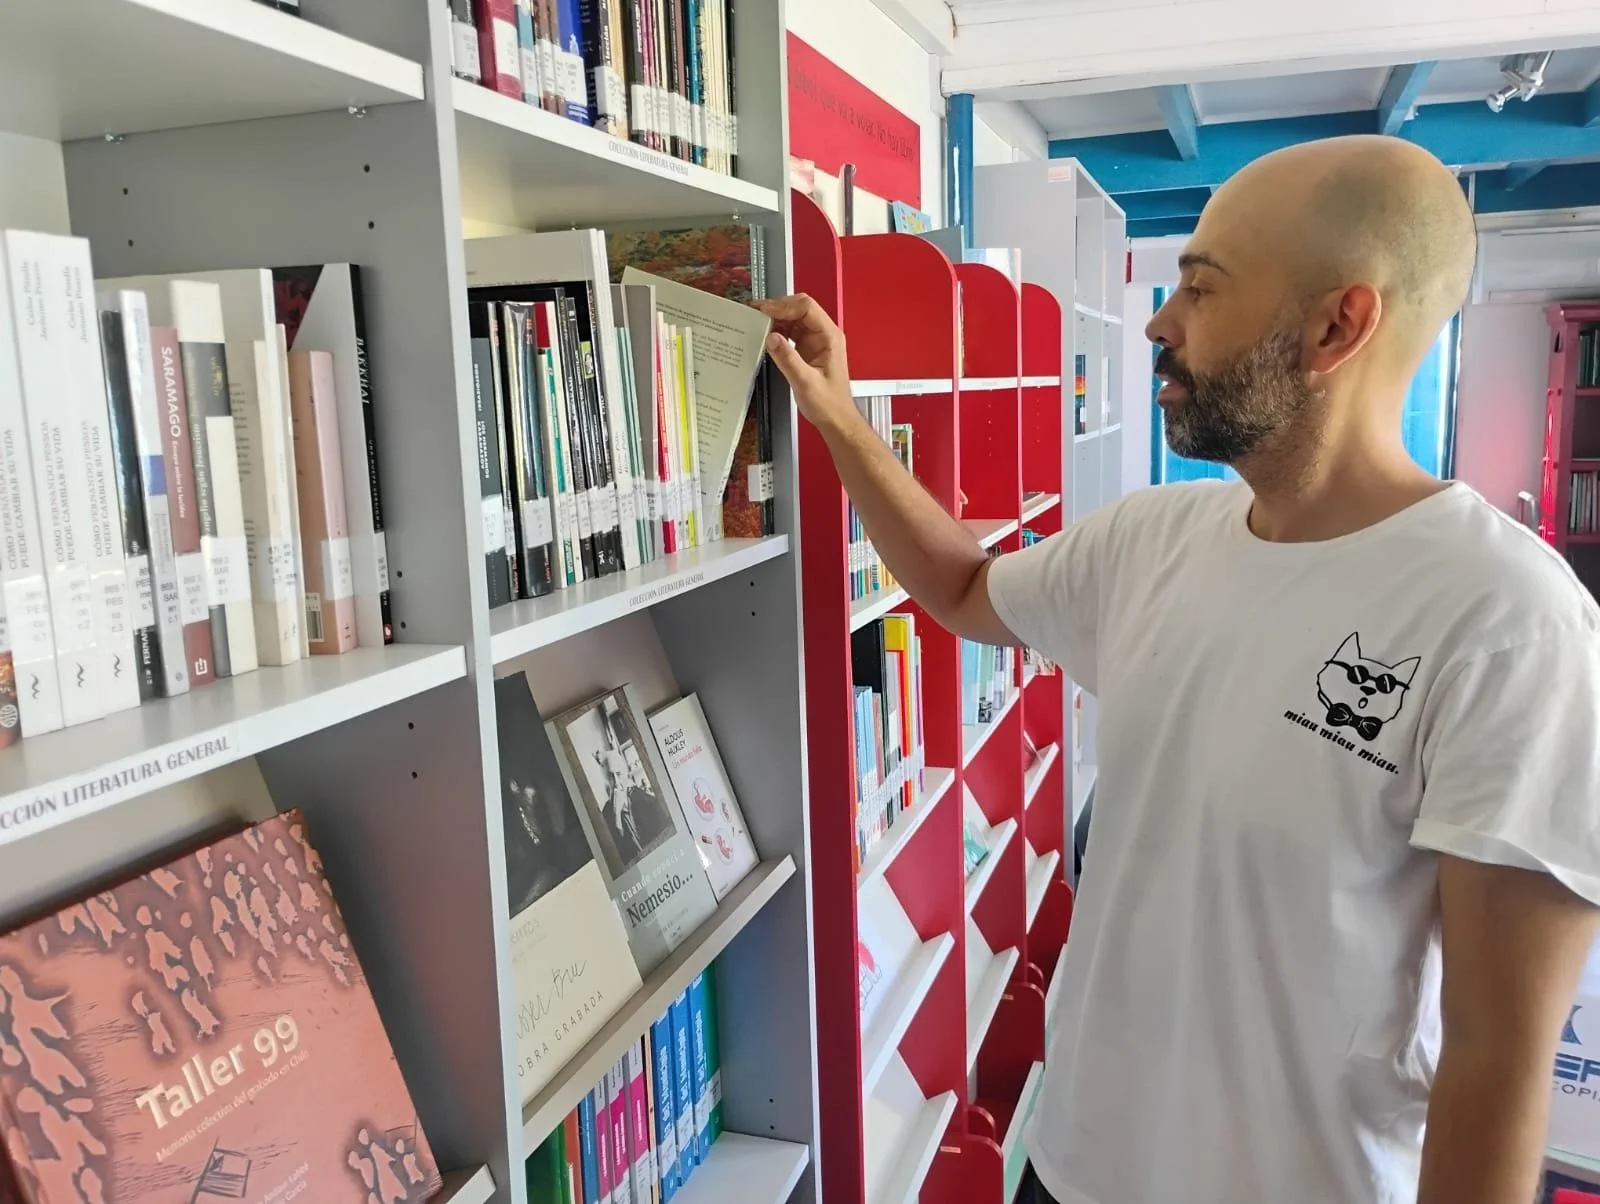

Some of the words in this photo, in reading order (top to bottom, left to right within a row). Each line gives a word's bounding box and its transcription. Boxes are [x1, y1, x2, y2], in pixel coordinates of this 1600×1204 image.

[161, 346, 182, 438] SARAMAGO
[3, 428, 15, 458] VIDA
[51, 425, 63, 454] VIDA
[90, 425, 102, 452] VIDA
[480, 435, 492, 479] HERMANOS
[6, 458, 17, 475] SU
[54, 455, 65, 471] SU
[9, 477, 26, 530] CAMBIAR
[45, 464, 61, 527] FERNANDO
[57, 472, 73, 523] CAMBIAR
[84, 462, 99, 523] FERNANDO
[95, 468, 110, 519] CAMBIAR
[16, 531, 30, 568] PUEDE
[63, 525, 77, 562] PUEDE
[102, 520, 115, 556] PUEDE
[664, 728, 685, 747] ALDOUS
[667, 740, 687, 757] HUXLEY
[1284, 710, 1318, 732] miau
[1319, 728, 1356, 751] miau
[1357, 749, 1399, 775] miau.
[62, 760, 163, 806] LITERATURA
[166, 736, 231, 771] GENERAL
[621, 873, 653, 902] Cuando
[626, 872, 694, 928] Nemesio...
[554, 990, 604, 1041] GRABADA
[136, 1042, 245, 1130] Taller
[253, 1014, 300, 1067] 99
[196, 1103, 235, 1138] colectiva
